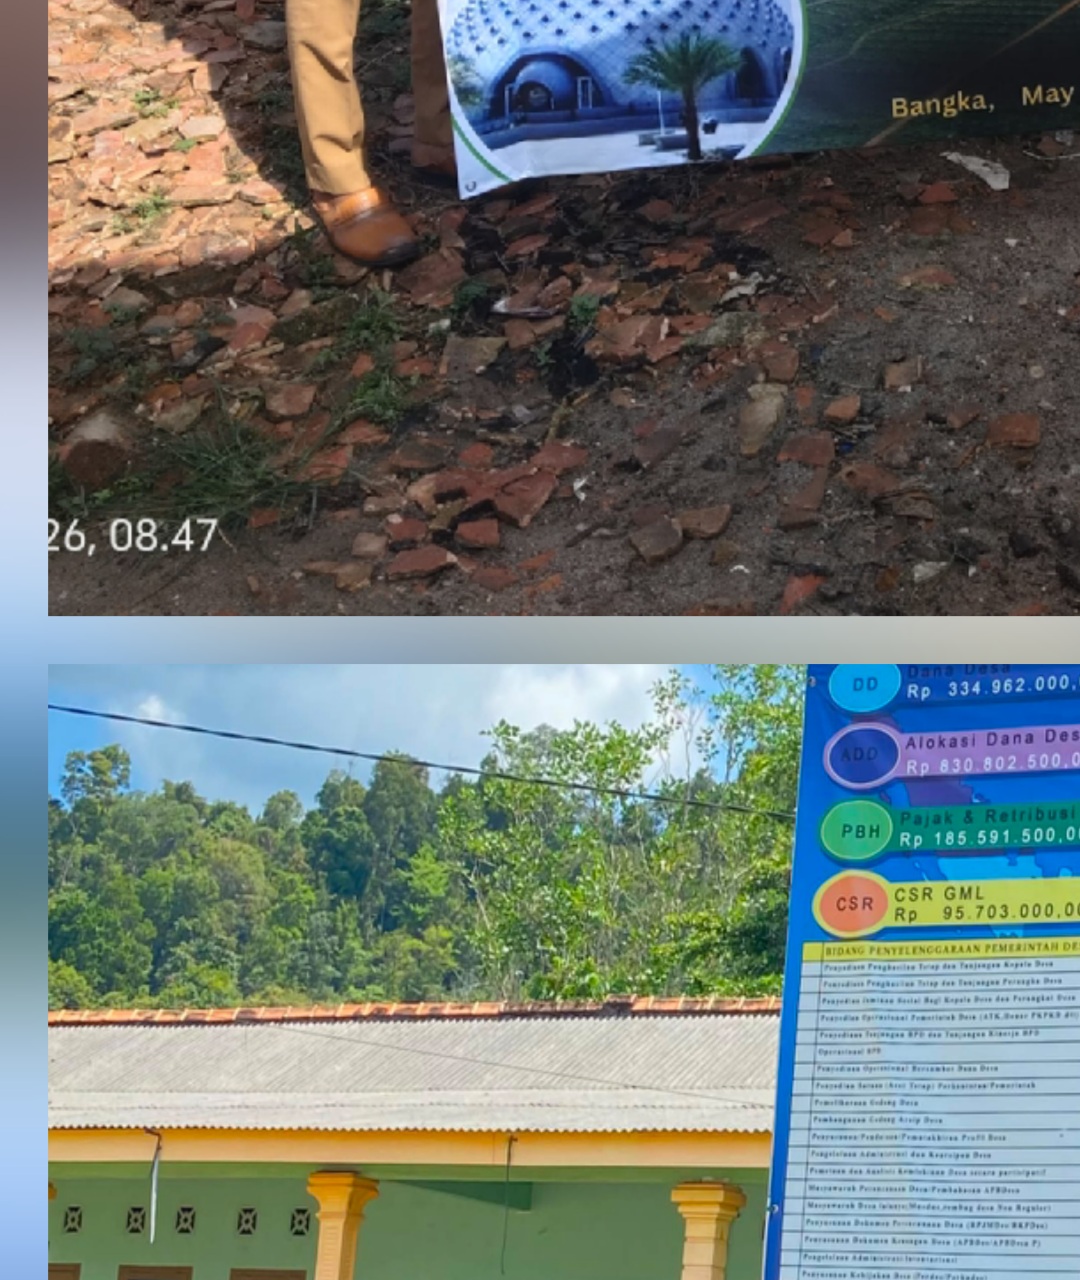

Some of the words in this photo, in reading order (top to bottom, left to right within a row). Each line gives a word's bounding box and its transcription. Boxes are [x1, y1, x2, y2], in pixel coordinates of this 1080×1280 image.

[892, 91, 995, 118] Bangka,
[1021, 85, 1074, 107] May
[852, 677, 879, 692] DD
[907, 684, 931, 701] Rp
[905, 735, 977, 750] Alokasi
[986, 731, 1035, 747] Dana
[841, 746, 879, 762] ADD
[906, 760, 930, 777] Rp
[900, 811, 954, 828] Pajak
[963, 810, 974, 824] &
[985, 806, 1076, 823] Retribusi
[841, 824, 880, 839] PBH
[900, 832, 923, 849] Rp
[894, 888, 934, 903] CSR
[944, 886, 985, 902] GML
[835, 896, 874, 912] CSR
[894, 908, 918, 924] Rp
[825, 948, 865, 956] BIDANG
[869, 945, 981, 955] PENYELENGGARAAN
[985, 941, 1059, 954] PEMERINTAH
